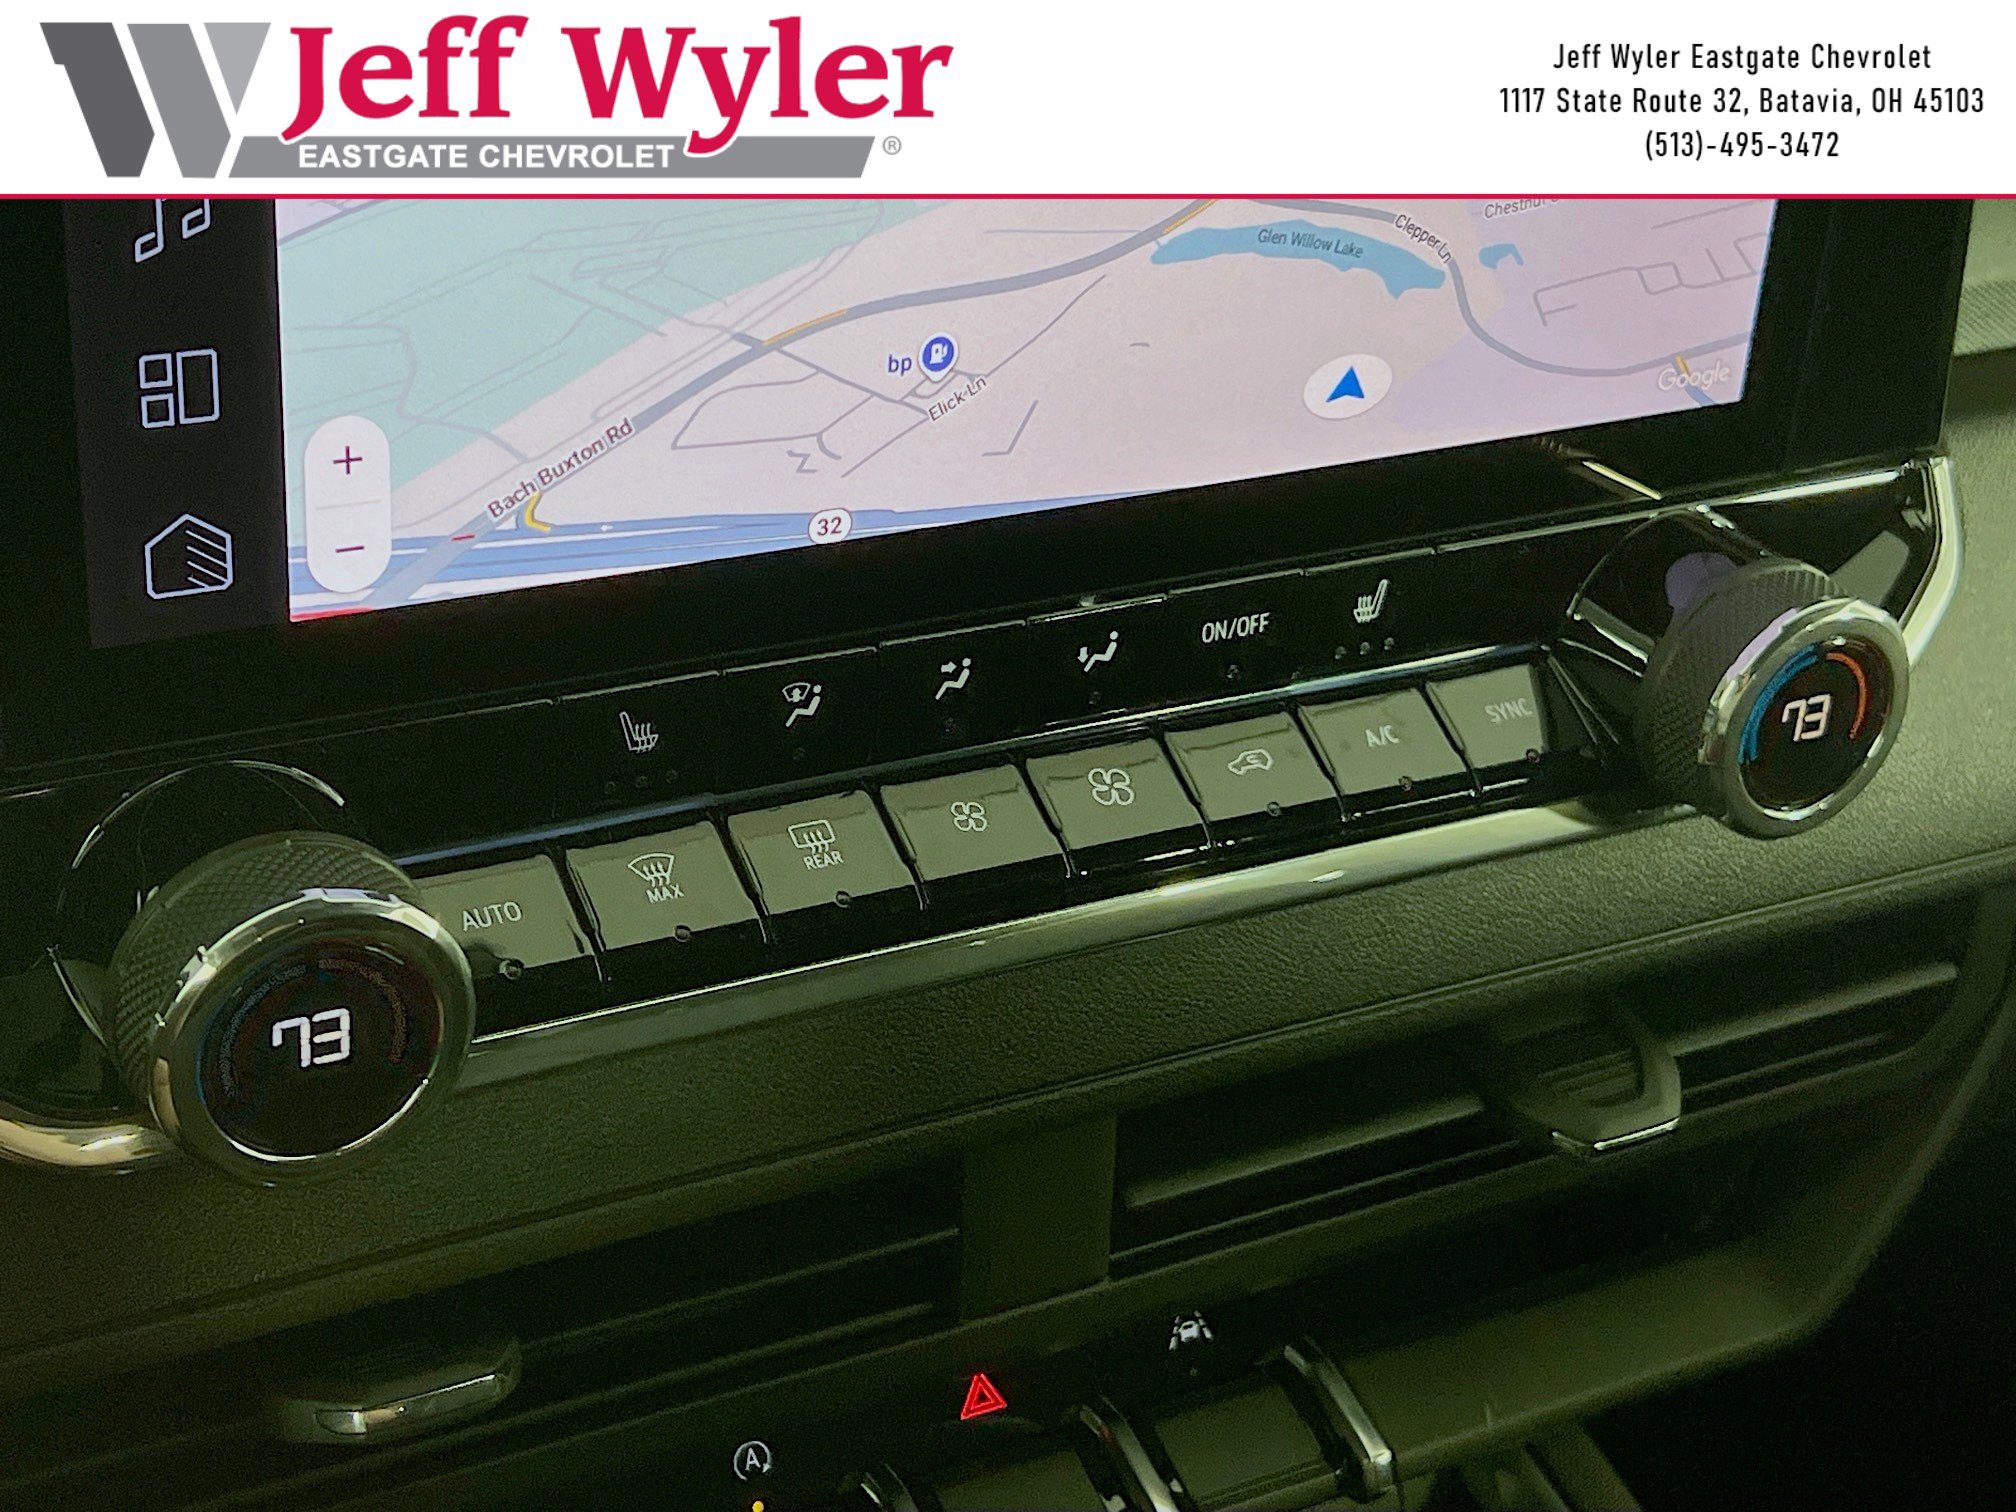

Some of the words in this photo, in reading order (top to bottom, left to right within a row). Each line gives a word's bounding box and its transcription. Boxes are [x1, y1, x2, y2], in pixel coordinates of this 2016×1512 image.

[1258, 229, 1287, 245] Glen
[1290, 232, 1333, 252] Willow
[1334, 240, 1364, 259] Lake
[1395, 214, 1441, 249] Clepper
[1437, 242, 1452, 264] Ln
[888, 353, 912, 377] bp
[1658, 360, 1730, 391] Google
[928, 391, 966, 421] Elick
[966, 378, 988, 397] Ln
[487, 481, 537, 518] Bach
[537, 440, 605, 486] Buxton
[605, 417, 633, 444] Rd
[817, 515, 844, 537] 32
[1201, 611, 1270, 645] ON/OFF
[1485, 696, 1533, 725] SYNC
[1782, 693, 1832, 742] 73
[1365, 723, 1400, 748] A/C
[803, 849, 845, 871] REAR
[646, 883, 685, 904] MAX
[461, 900, 523, 932] AUTO
[271, 1007, 351, 1068] 73
